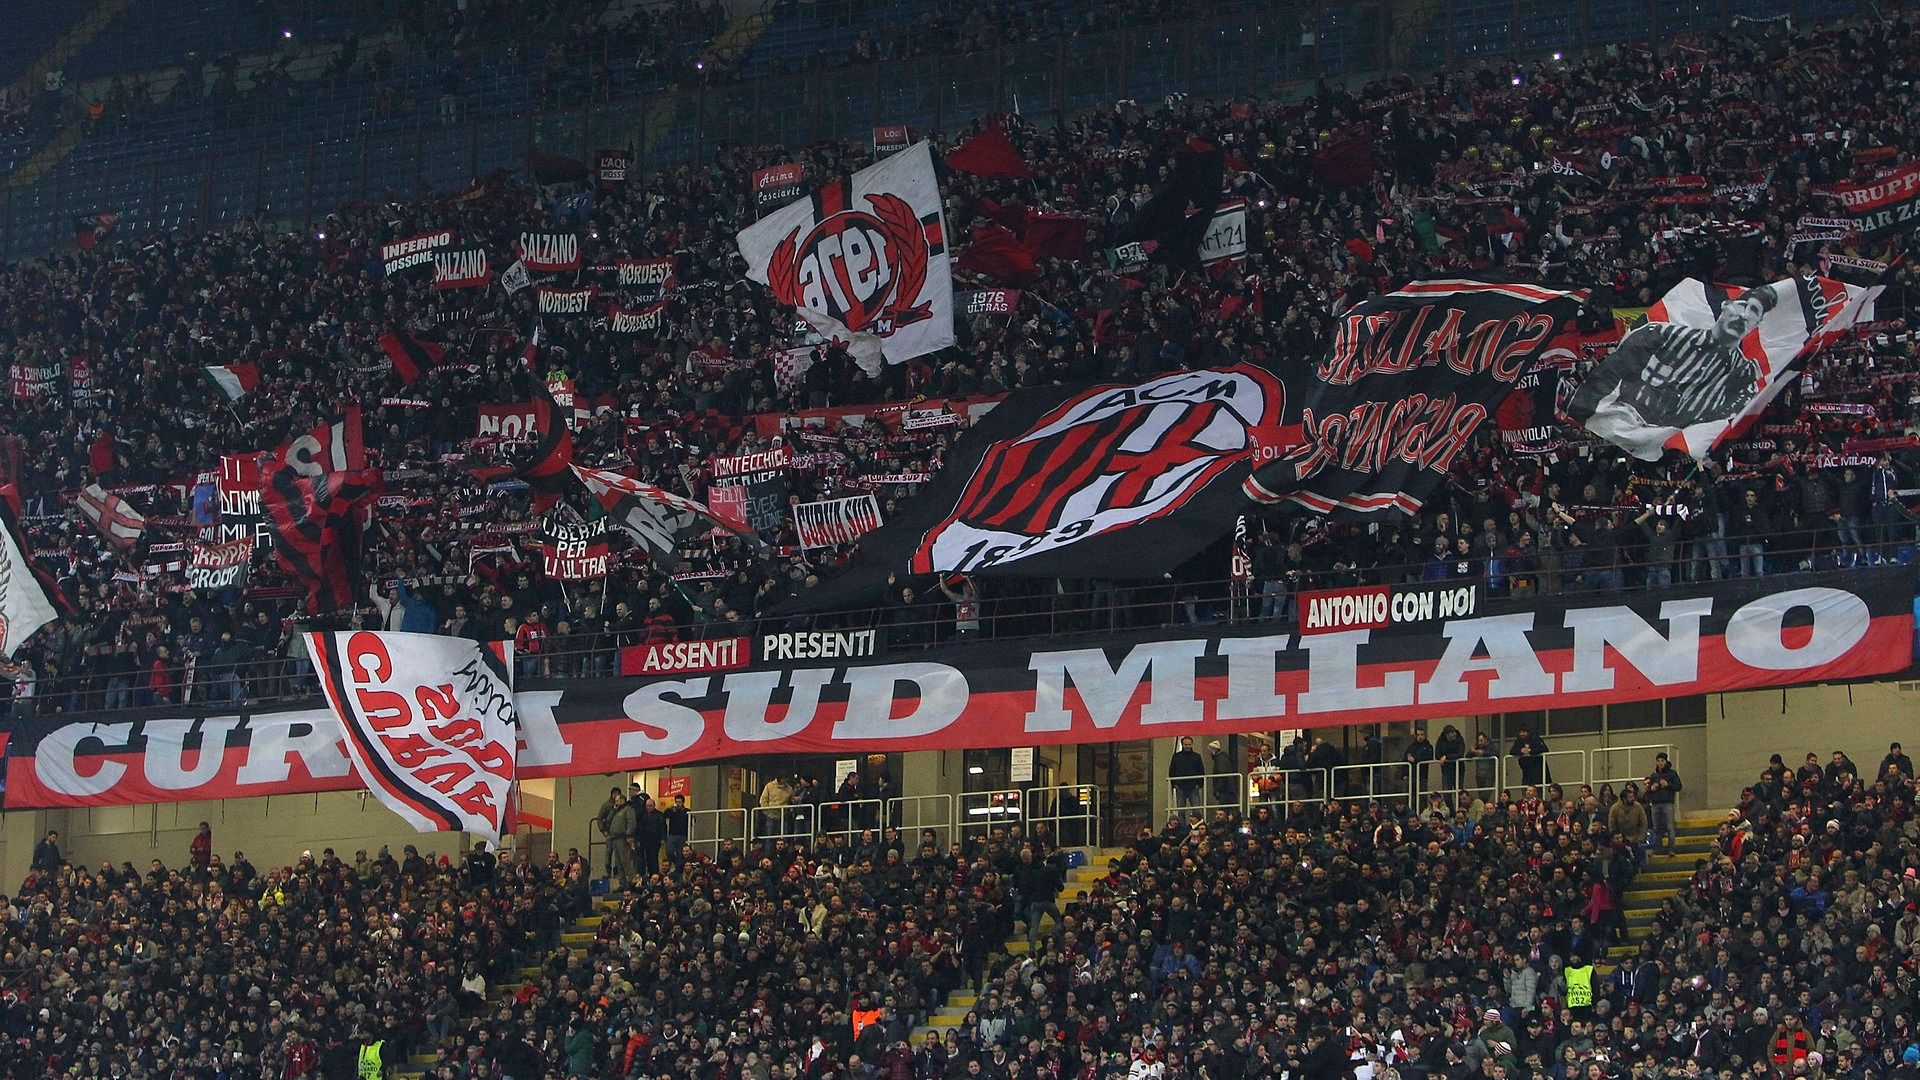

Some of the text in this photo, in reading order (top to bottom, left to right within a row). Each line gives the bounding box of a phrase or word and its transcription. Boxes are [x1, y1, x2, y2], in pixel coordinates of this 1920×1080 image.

[759, 170, 794, 188] Anima
[382, 232, 450, 260] INFERNO
[520, 231, 577, 264] SALZANO
[434, 248, 487, 282] SALZANO
[538, 290, 592, 314] NORDEST
[967, 302, 1009, 314] ULTRAS
[972, 291, 1005, 305] 1976
[611, 306, 665, 333] NORDEST
[220, 455, 241, 482] TI
[736, 493, 778, 517] NEVER
[844, 495, 879, 540] SUD
[556, 540, 588, 559] PER
[190, 565, 239, 589] GROUP
[1306, 585, 1477, 629] ANTONIO CON NOI
[642, 638, 739, 672] ASSENTI
[762, 629, 877, 661] PRESENTI
[618, 662, 970, 759] SUD
[1024, 587, 1871, 734] MILANO
